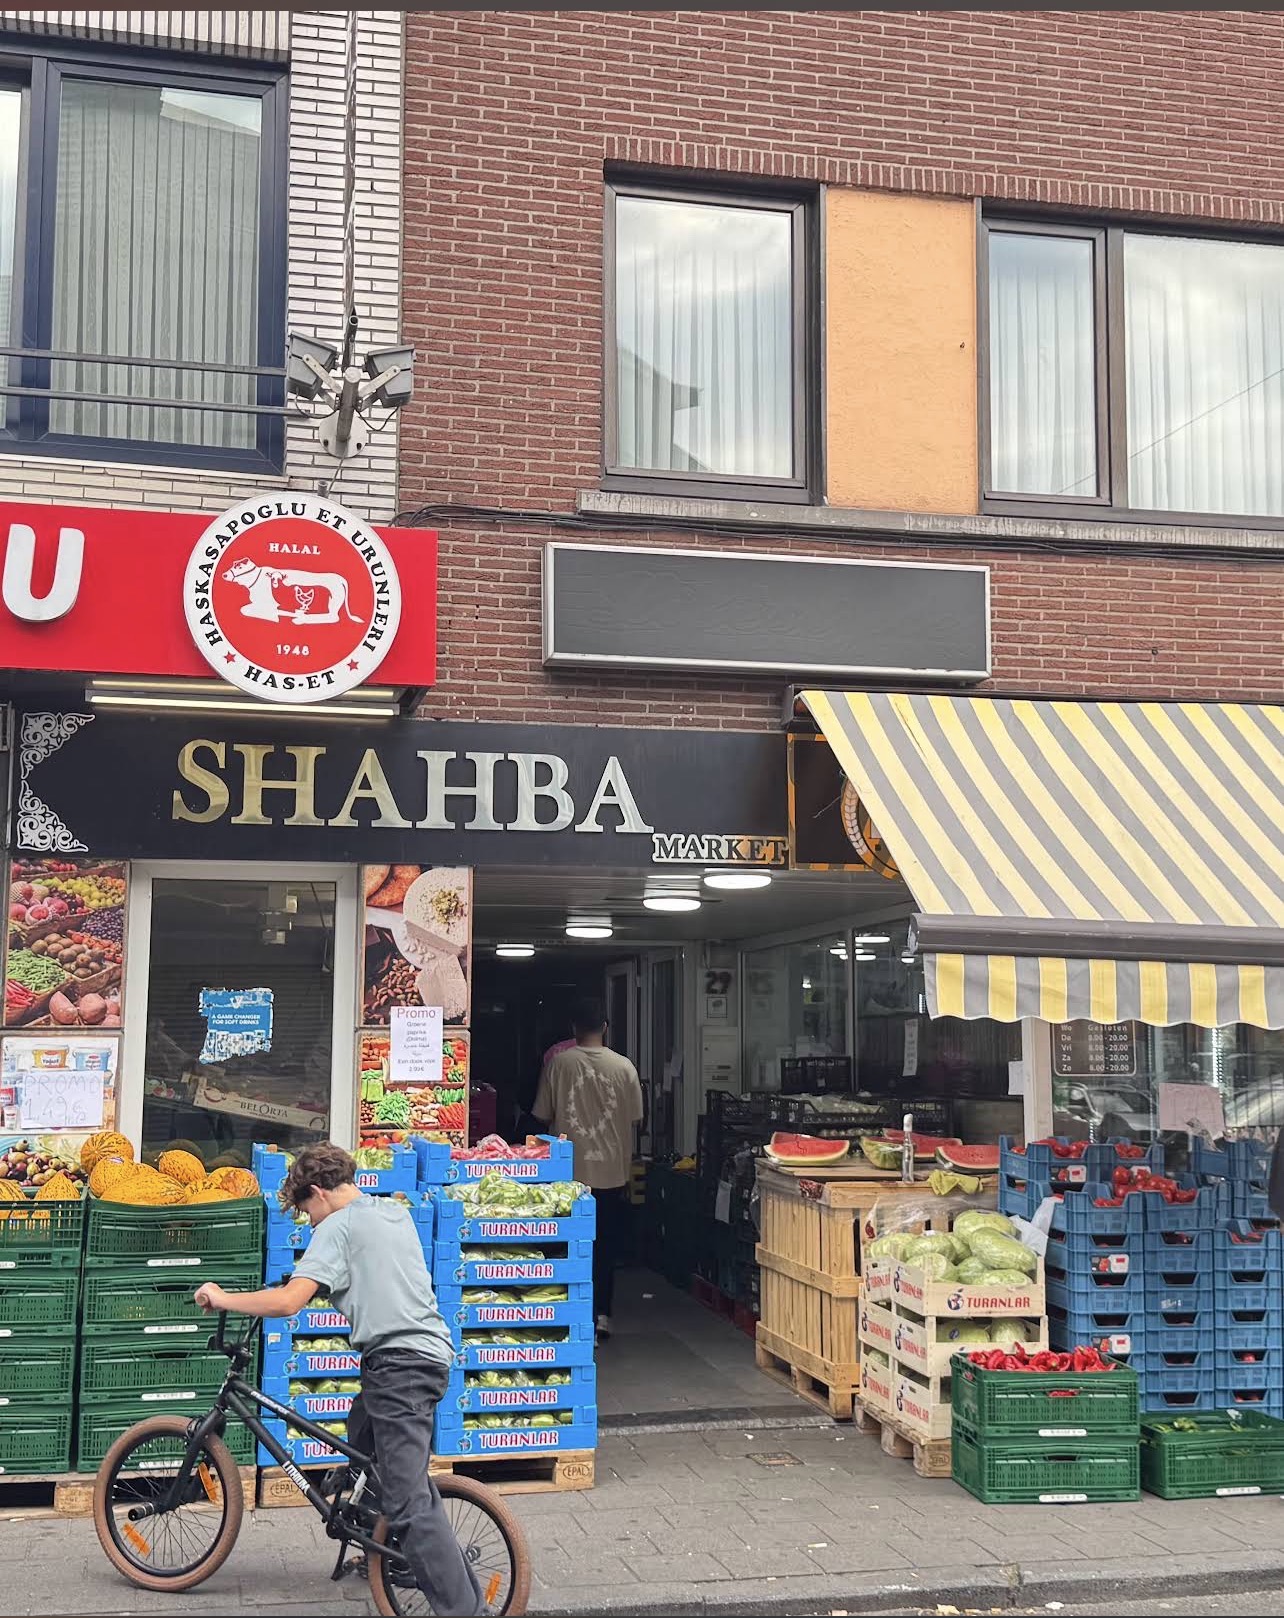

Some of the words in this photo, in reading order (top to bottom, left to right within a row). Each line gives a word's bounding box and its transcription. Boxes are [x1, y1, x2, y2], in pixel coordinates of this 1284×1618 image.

[269, 542, 321, 555] HALAL
[315, 507, 347, 530] ET
[351, 530, 391, 652] URUNLERI
[276, 644, 310, 656] 1948
[244, 665, 335, 690] HAS-ET
[171, 738, 655, 833] SHAHBA
[653, 834, 788, 864] MARKET
[397, 1007, 436, 1018] Promo
[240, 1102, 288, 1118] BELORTA
[479, 1222, 558, 1237] TURANLAR
[475, 1264, 554, 1279] TURANLAR
[966, 1297, 1031, 1309] TURANLAR
[307, 1312, 350, 1328] TURA
[476, 1306, 555, 1322] TURANLAR
[306, 1355, 361, 1371] TURAN
[477, 1347, 556, 1363] TURANLAR
[479, 1389, 558, 1406] TURANLAR
[479, 1430, 559, 1448] TURANLAR
[282, 1460, 312, 1495] LITHIUM
[567, 1467, 586, 1477] EPAL
